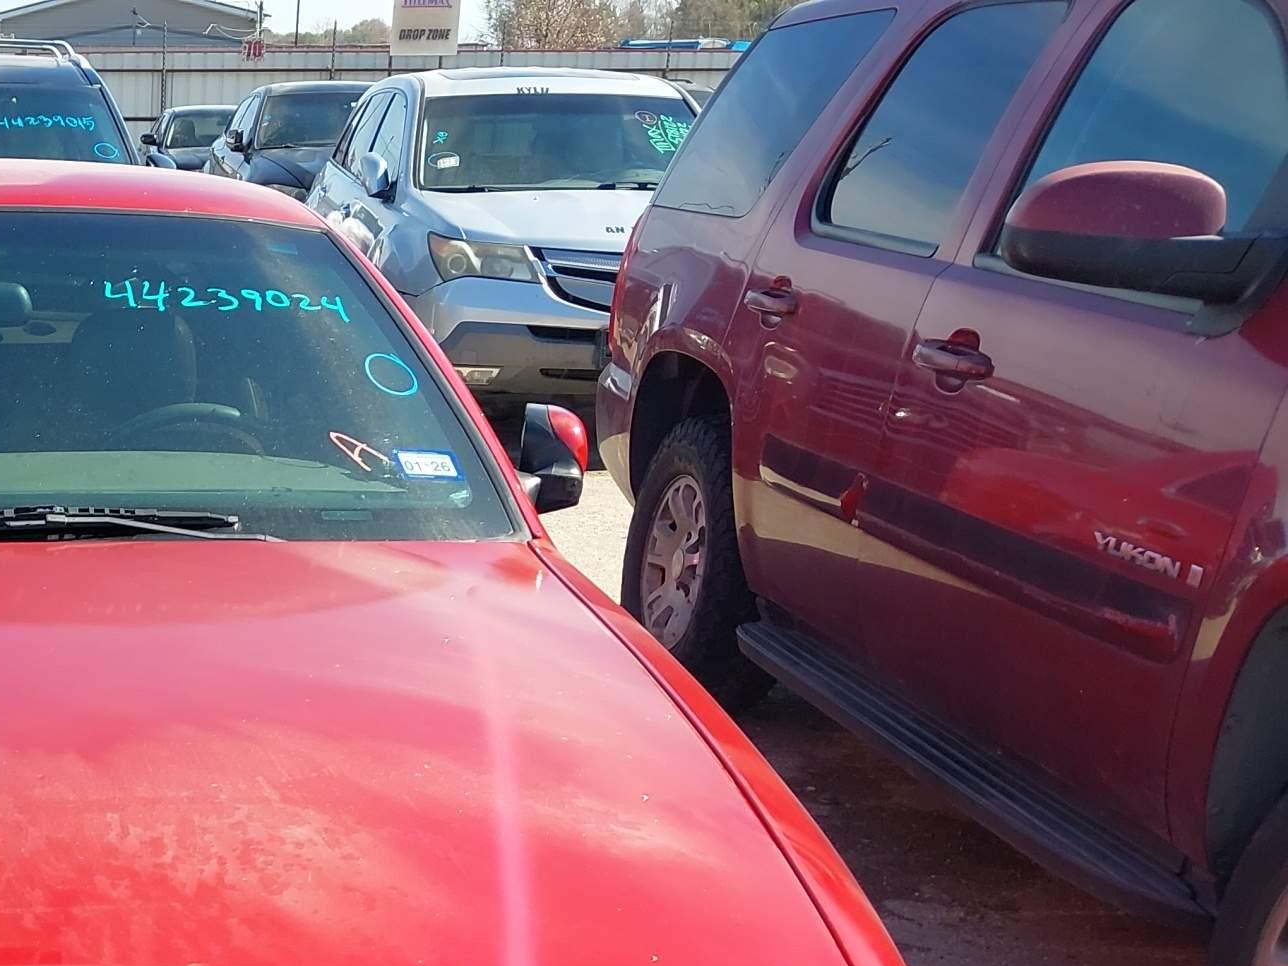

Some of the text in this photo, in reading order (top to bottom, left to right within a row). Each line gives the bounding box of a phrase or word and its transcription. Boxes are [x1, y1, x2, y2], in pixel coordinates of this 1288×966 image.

[399, 28, 451, 40] DROP ZONE
[104, 278, 351, 323] 44239024
[404, 460, 451, 473] 01 26
[1094, 531, 1181, 579] YUKON
